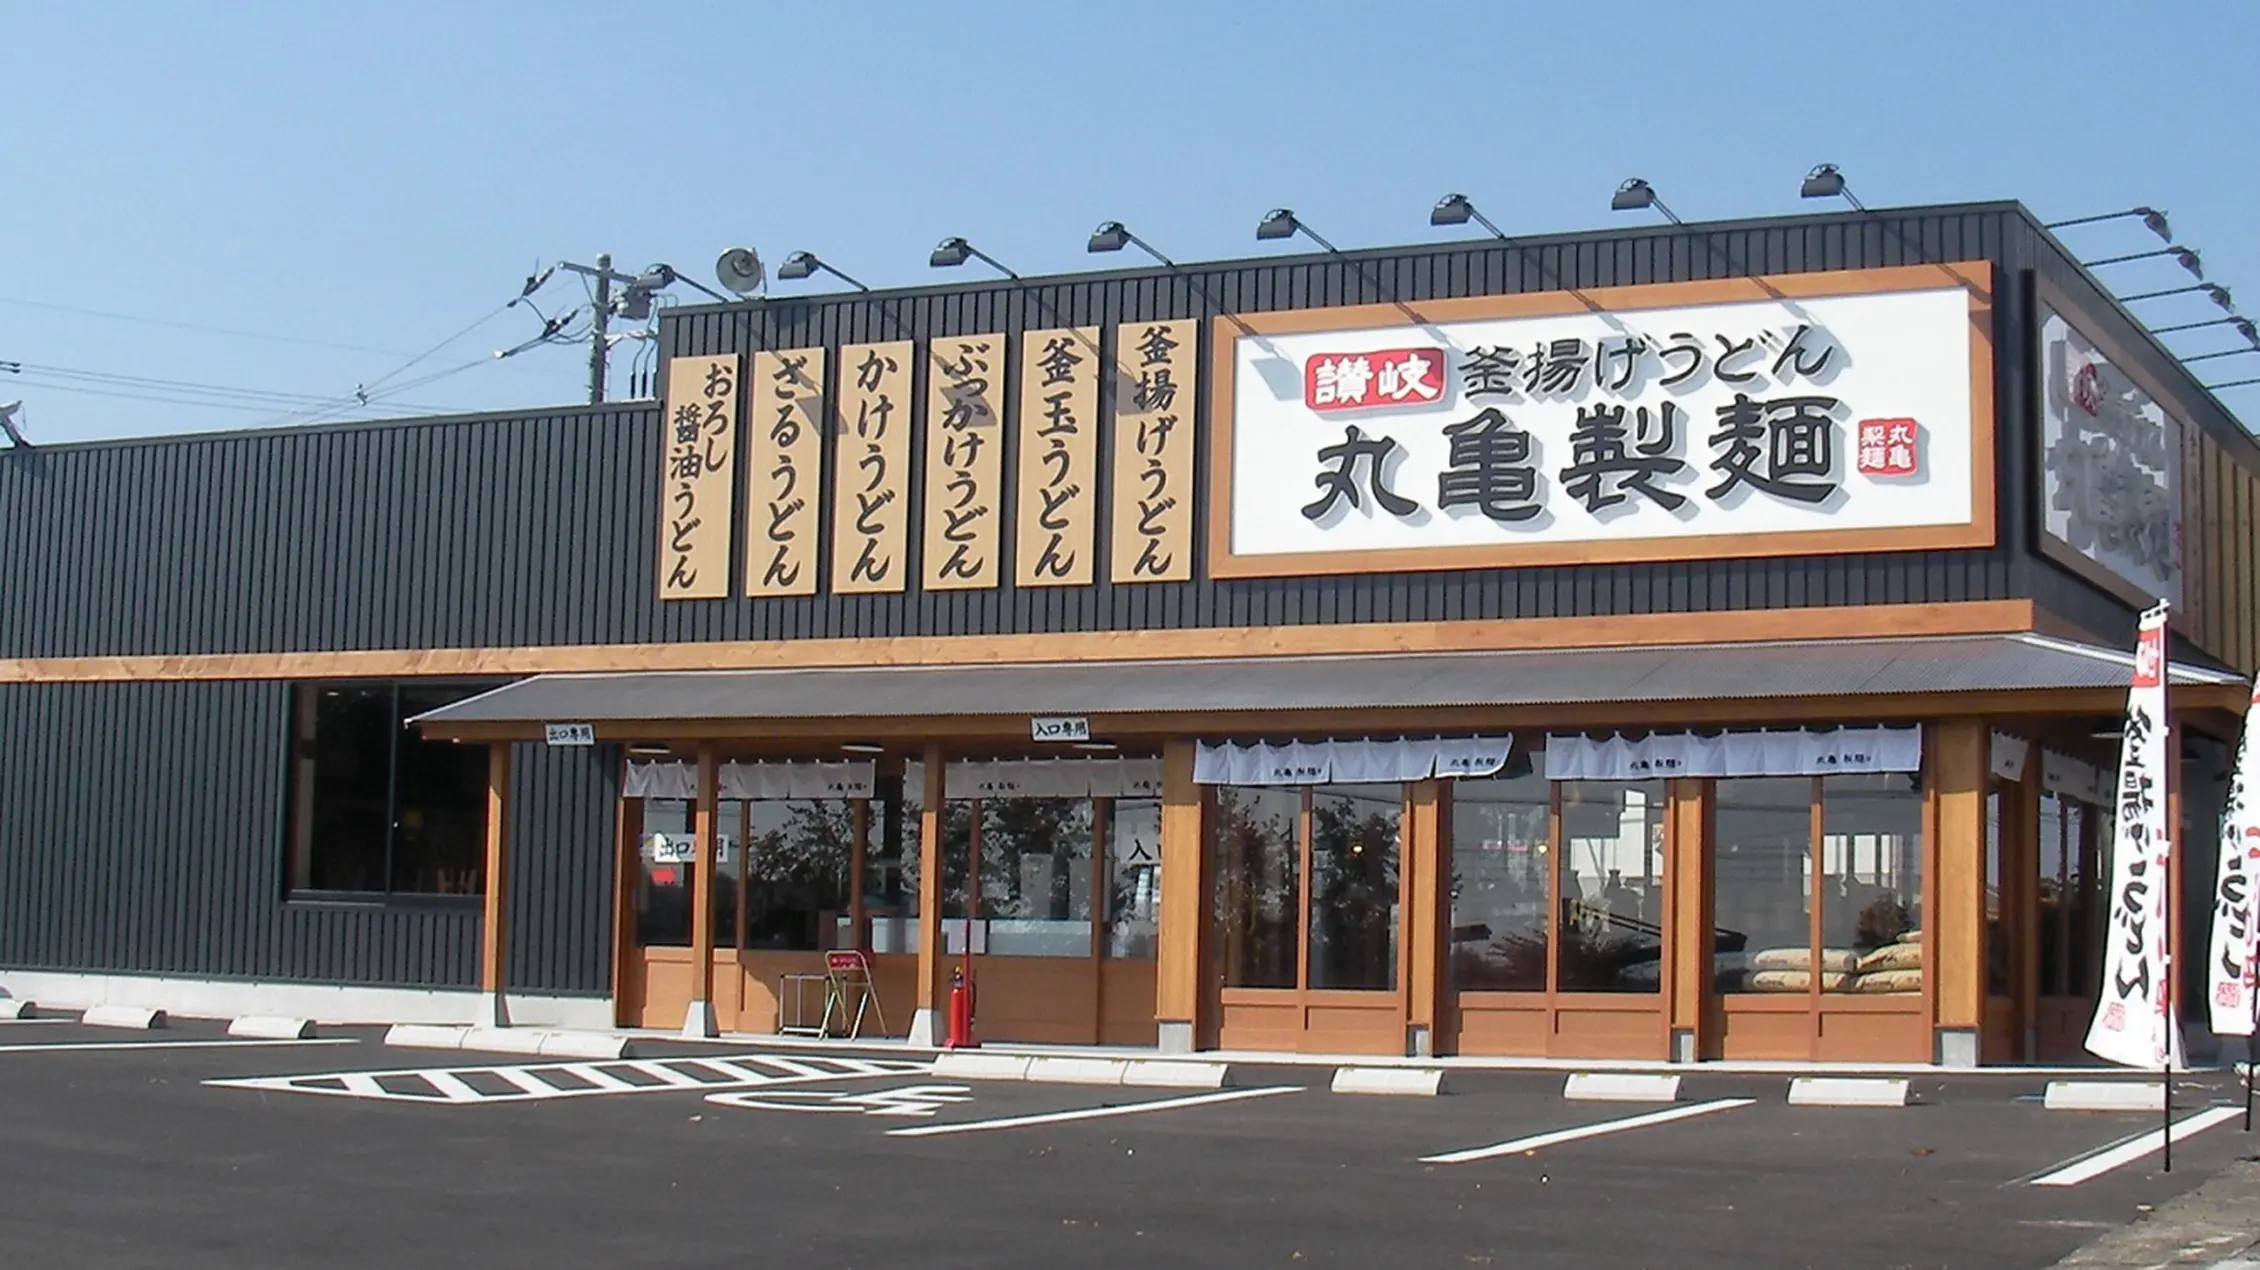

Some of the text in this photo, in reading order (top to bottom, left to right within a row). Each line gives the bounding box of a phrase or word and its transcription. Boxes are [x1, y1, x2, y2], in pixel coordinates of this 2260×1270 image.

[703, 362, 733, 472] おろし
[762, 357, 804, 588] ざるうどん
[850, 349, 898, 582] かけうどん
[938, 343, 990, 579] ぶっかけうどん
[1034, 336, 1083, 579] 釜玉うどん
[1132, 326, 1179, 575] 釜揚げうどん
[1301, 393, 1839, 522] 丸亀製麺
[1458, 325, 1832, 400] 釜揚げうどん
